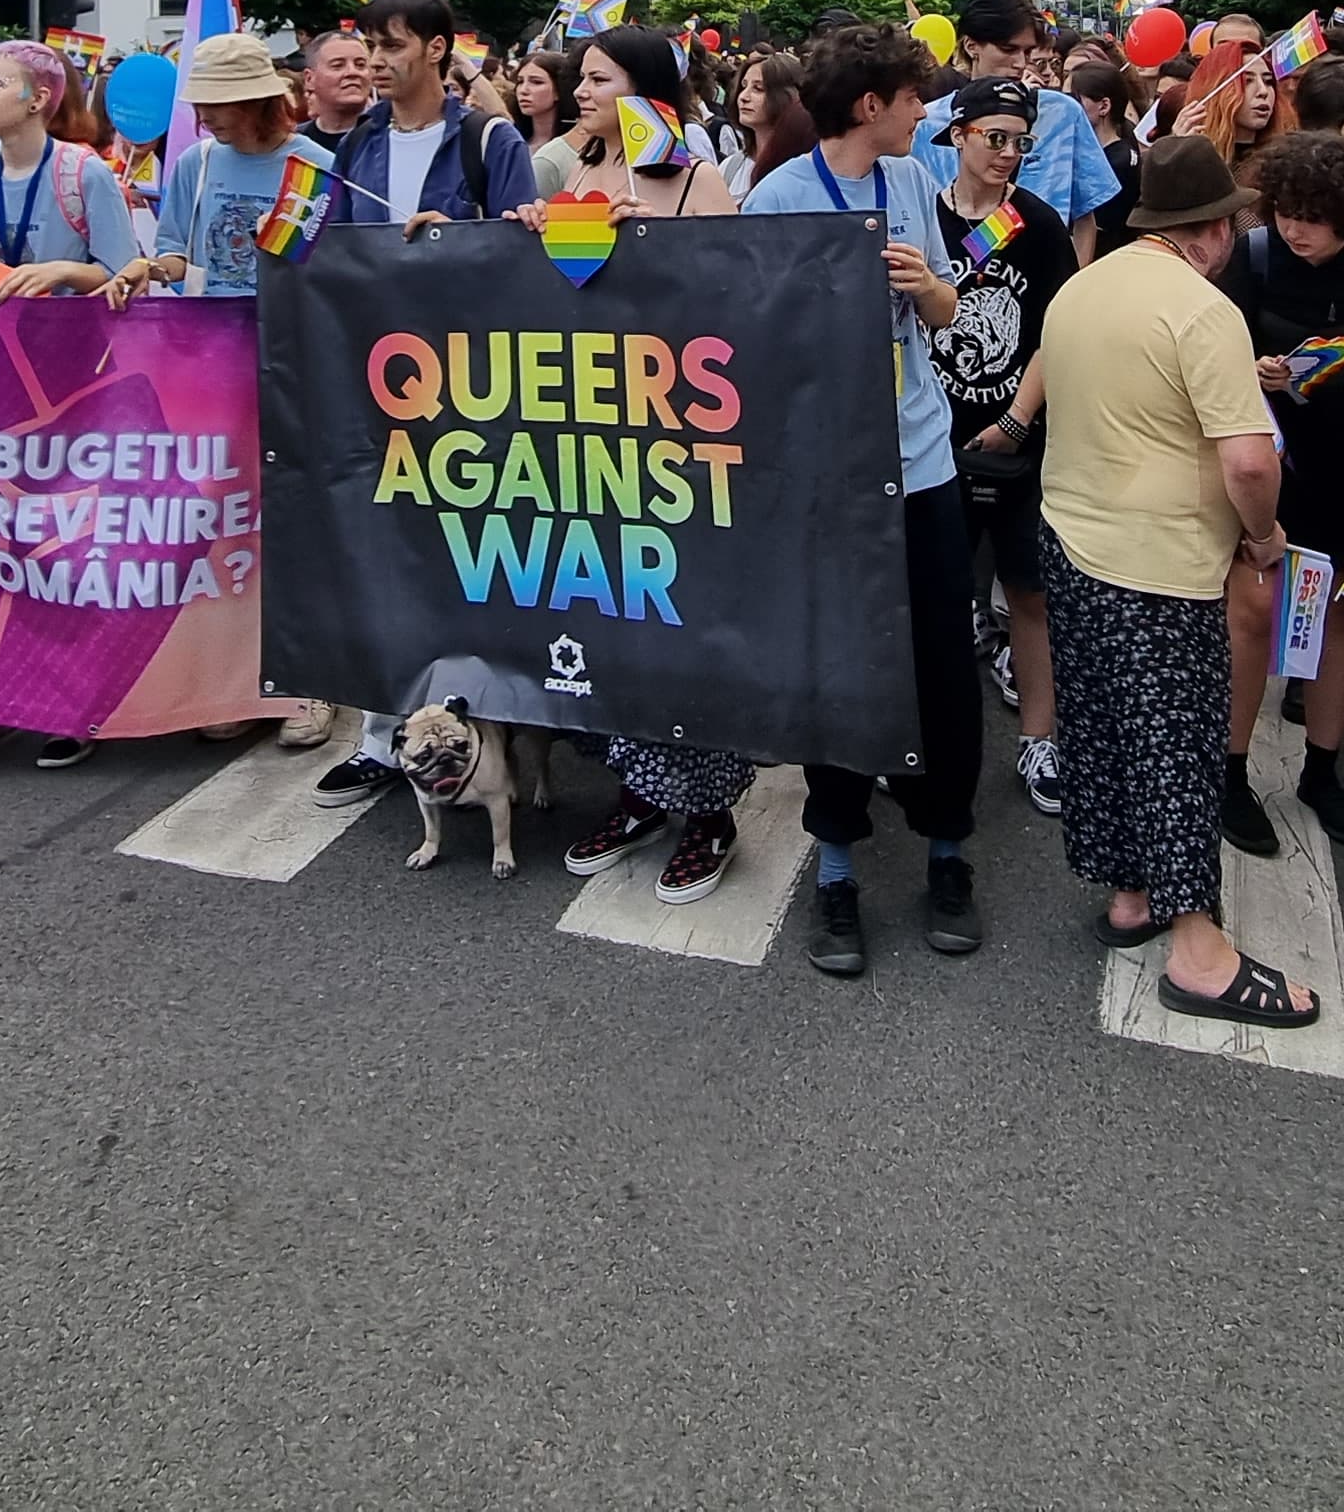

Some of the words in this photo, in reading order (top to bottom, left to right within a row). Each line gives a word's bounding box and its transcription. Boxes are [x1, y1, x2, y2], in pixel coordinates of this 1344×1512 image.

[367, 331, 742, 434] QUEERS
[372, 429, 745, 528] AGAINST
[437, 511, 685, 627] WAR
[544, 677, 593, 698] accept
